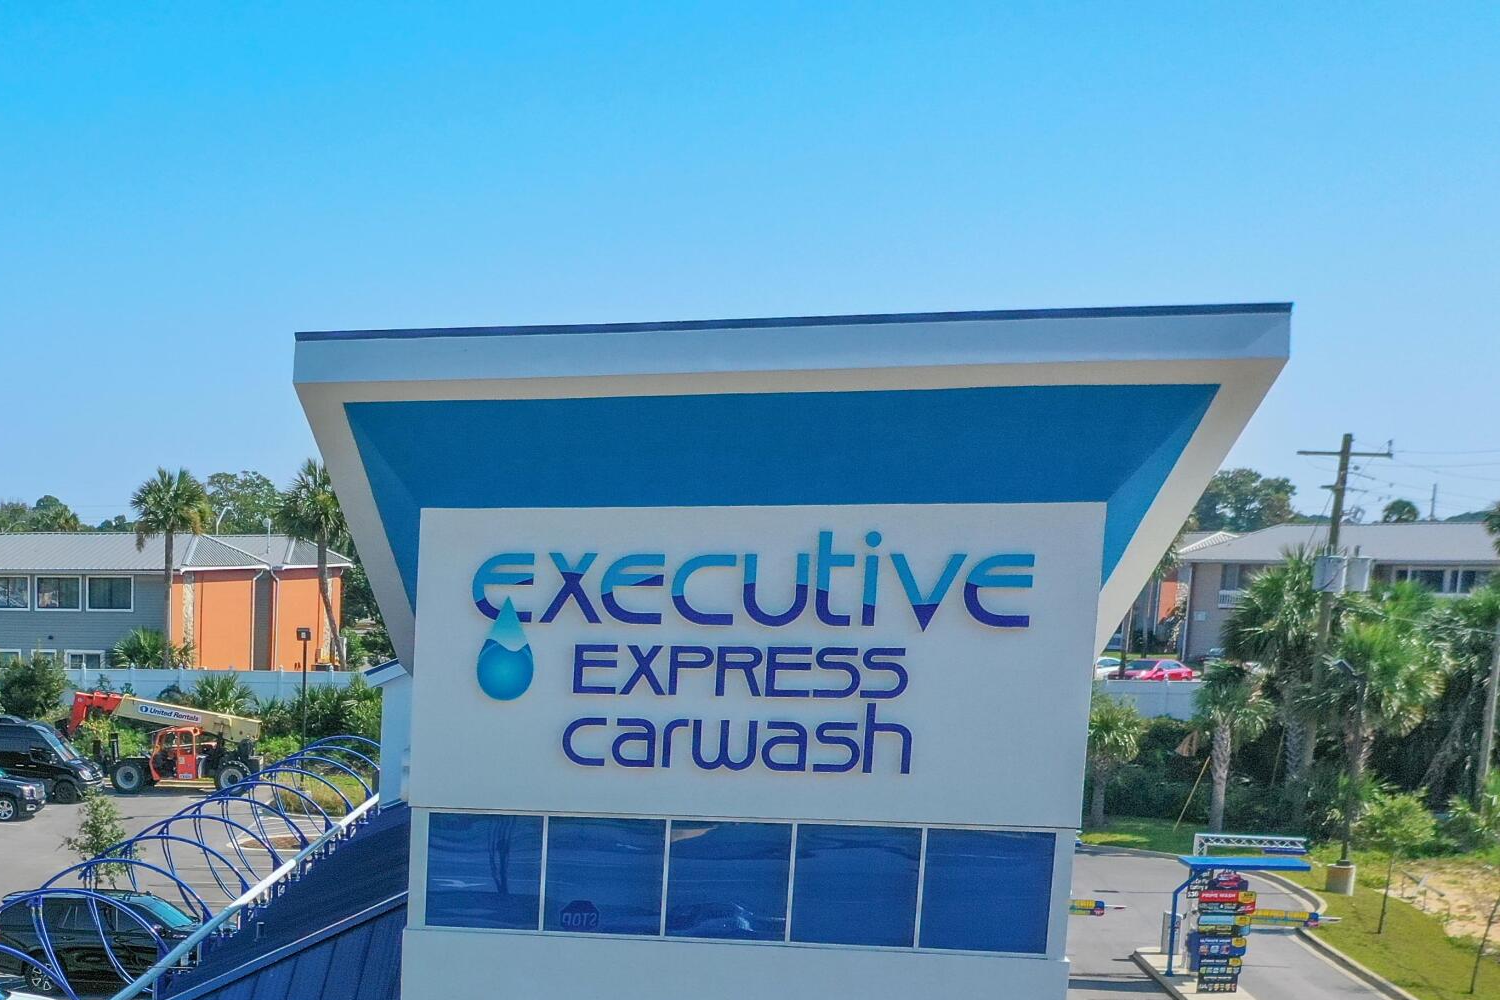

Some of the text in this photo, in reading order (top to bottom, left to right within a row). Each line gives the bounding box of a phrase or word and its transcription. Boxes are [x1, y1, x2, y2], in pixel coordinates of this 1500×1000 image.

[573, 644, 909, 699] EXPRESS
[150, 708, 199, 721] United Rentals
[562, 702, 913, 775] carwash
